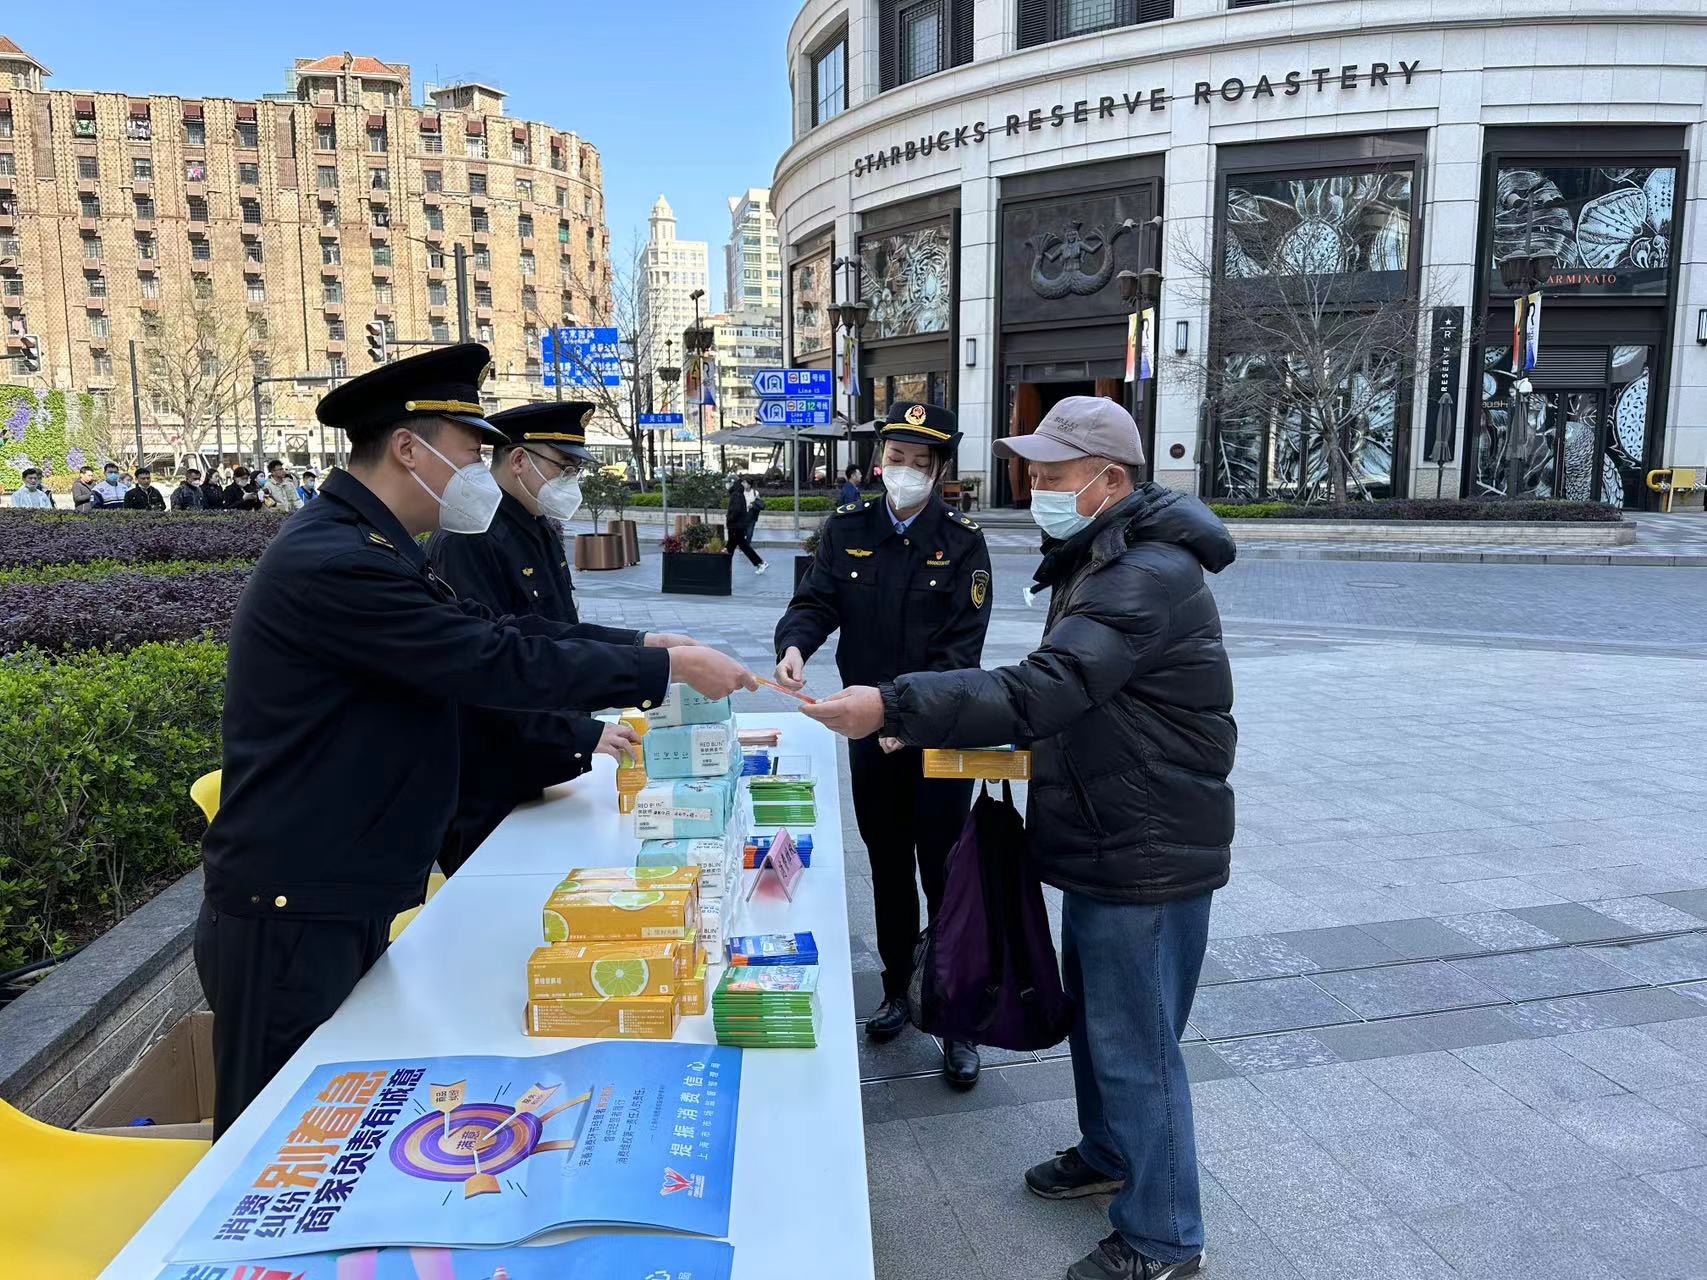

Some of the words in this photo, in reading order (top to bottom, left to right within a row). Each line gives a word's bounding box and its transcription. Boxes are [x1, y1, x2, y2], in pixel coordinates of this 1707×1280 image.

[854, 121, 985, 177] STARBUCKS
[1006, 87, 1166, 136] RESERVE
[1194, 60, 1420, 105] ROASTERY
[1441, 346, 1451, 392] RESERVE
[807, 401, 816, 410] 12
[253, 1070, 389, 1188] 别着急
[669, 1061, 706, 1158] 提振消费信心
[293, 1067, 427, 1234] 商家负责有诚意
[456, 1130, 480, 1150] 满意
[213, 1194, 275, 1241] 消费
[254, 1191, 311, 1238] 纠纷
